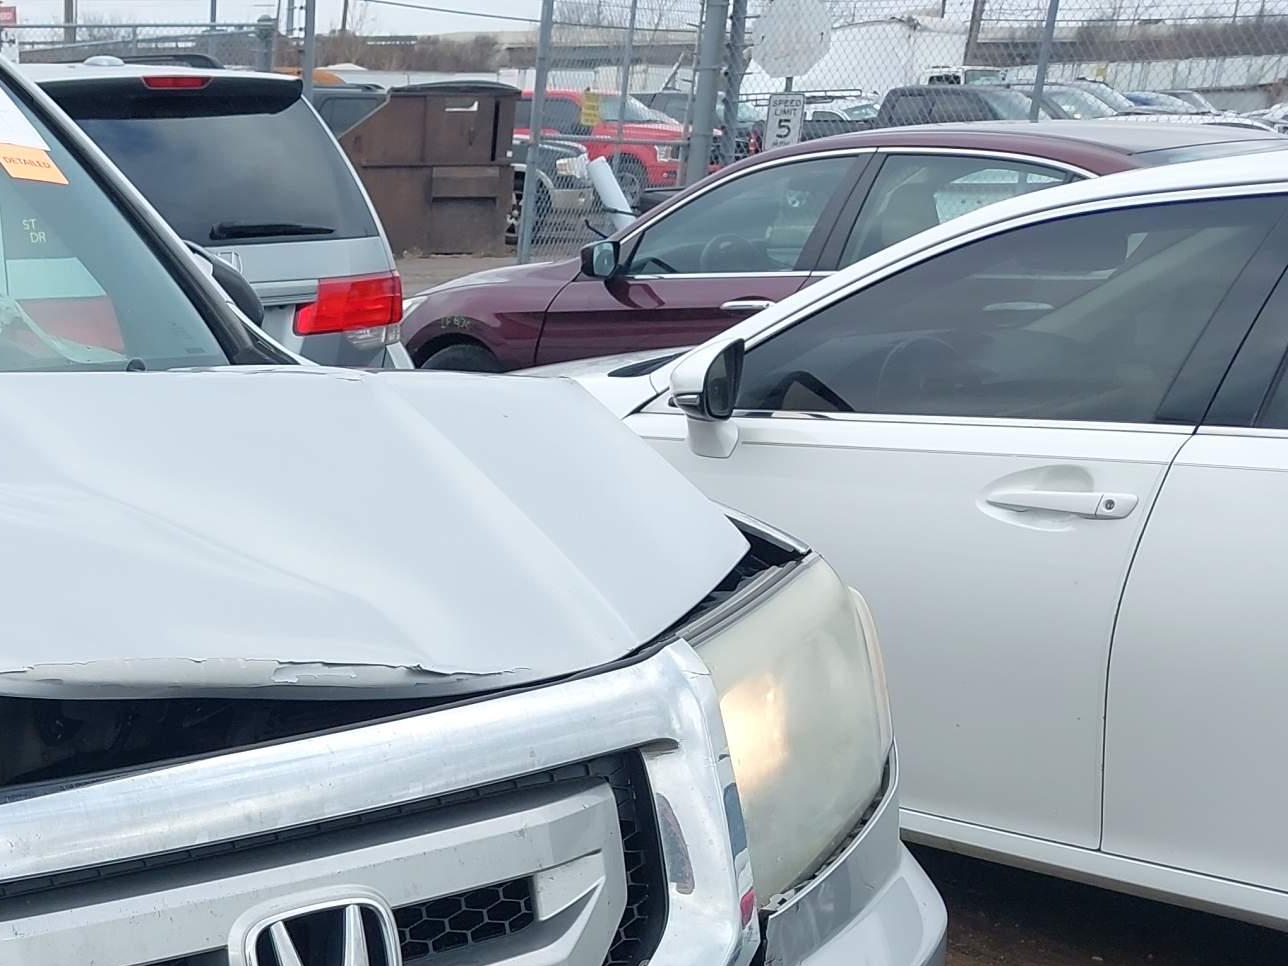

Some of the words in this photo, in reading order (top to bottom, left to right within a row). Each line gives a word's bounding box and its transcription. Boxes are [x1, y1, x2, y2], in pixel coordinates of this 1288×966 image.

[772, 99, 802, 107] SPEED
[774, 108, 798, 117] LIMIT
[775, 118, 792, 138] 5
[30, 231, 47, 243] DR
